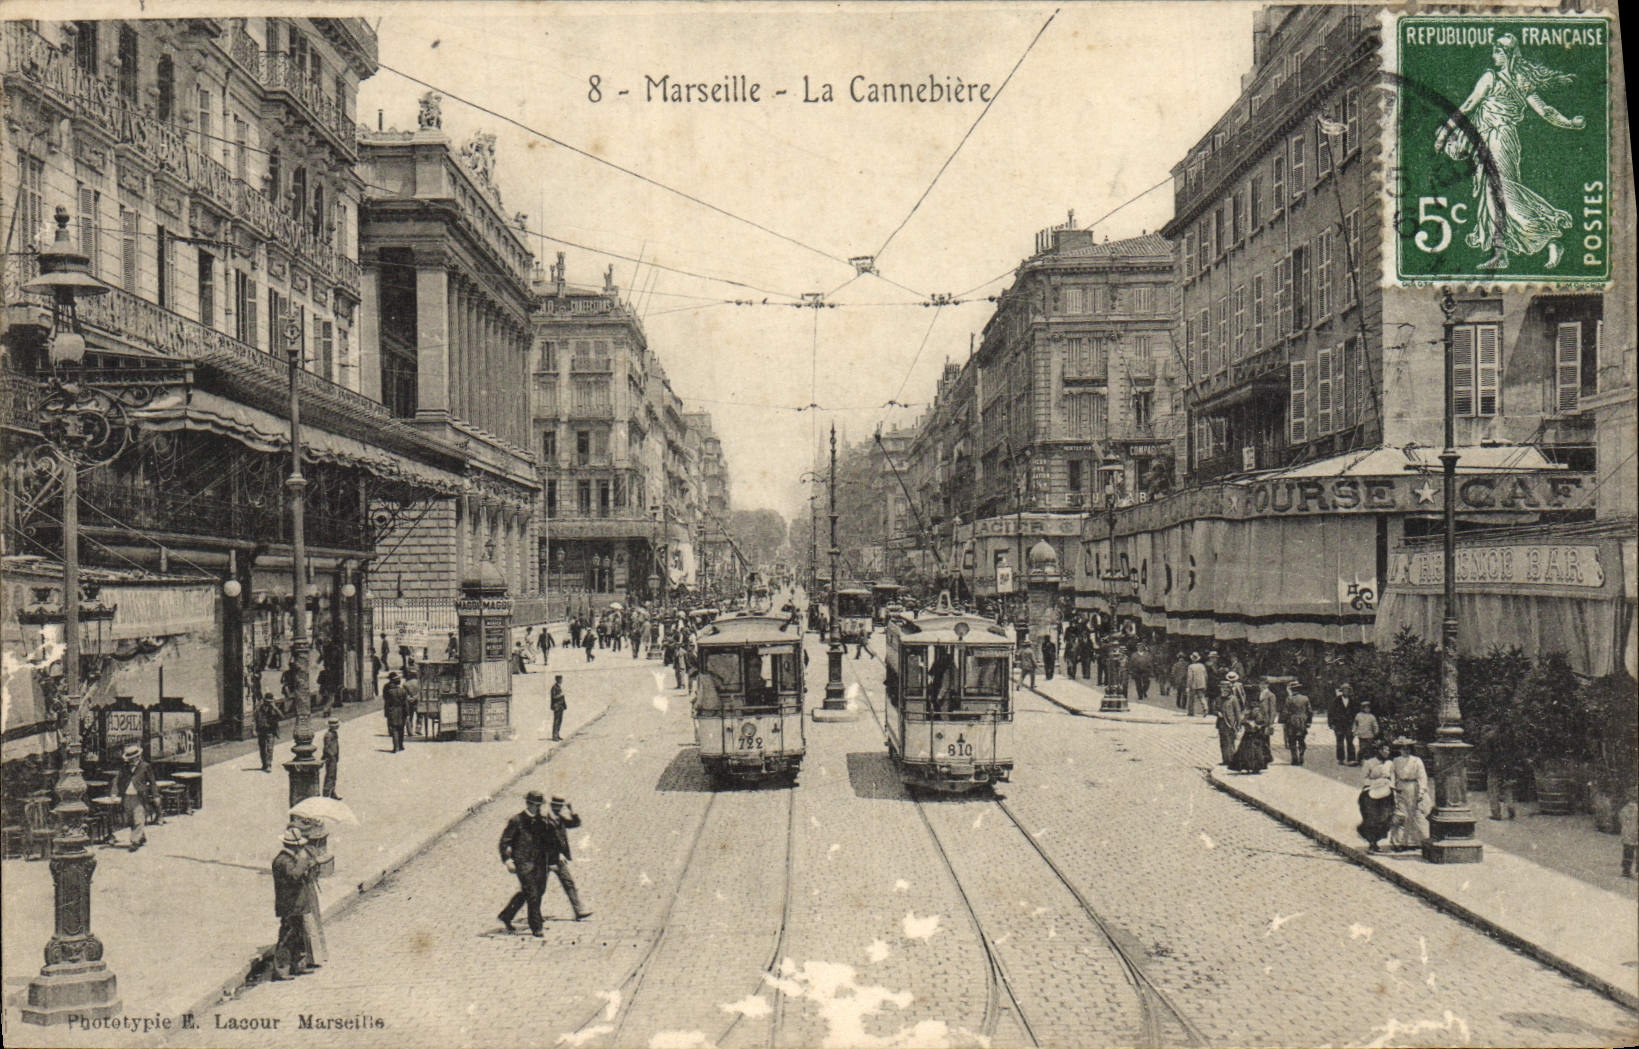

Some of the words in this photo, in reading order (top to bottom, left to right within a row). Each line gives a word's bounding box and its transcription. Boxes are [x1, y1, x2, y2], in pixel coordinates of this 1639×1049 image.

[1406, 26, 1495, 48] REPUBLIQUE
[1522, 27, 1603, 50] FRANÇAISE
[1584, 180, 1604, 266] POSTES
[1247, 478, 1397, 514] OURSE
[1527, 546, 1585, 582] BAR
[738, 737, 764, 750] 722
[947, 744, 974, 757] 810
